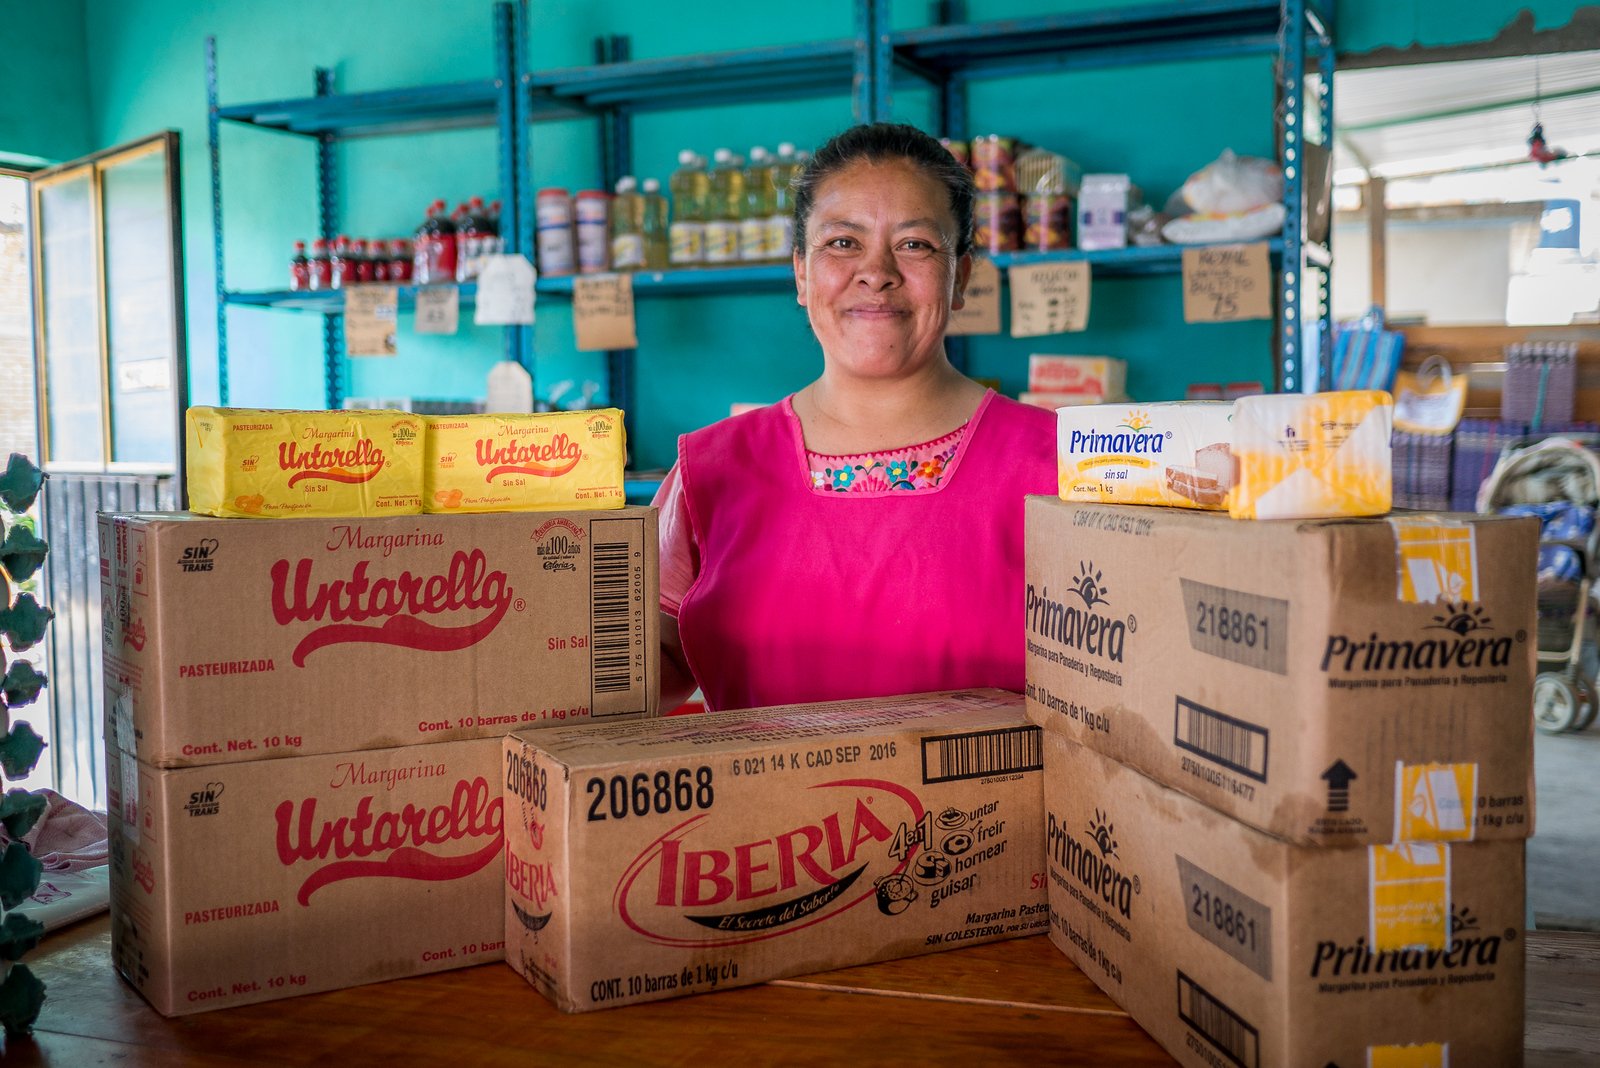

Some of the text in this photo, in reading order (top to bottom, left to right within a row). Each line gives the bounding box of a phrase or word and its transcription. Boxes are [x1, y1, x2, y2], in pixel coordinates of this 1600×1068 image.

[302, 428, 355, 442] Margarina
[429, 422, 469, 430] PASTEURIZADA
[498, 425, 549, 439] Margarina
[475, 432, 583, 466] Untarella
[1069, 429, 1164, 454] Primavera
[279, 438, 385, 471] Untarella
[503, 479, 526, 487] Sin Sal
[1104, 469, 1128, 479] sin sal
[317, 484, 328, 492] Sal
[575, 492, 593, 500] Cont.
[594, 491, 608, 499] Net.
[613, 490, 623, 498] kg
[1099, 484, 1103, 492] 1
[1105, 485, 1113, 494] kg
[375, 500, 392, 508] Cont.
[394, 499, 408, 507] Net.
[415, 499, 422, 507] kg
[183, 546, 210, 560] SIN
[326, 525, 445, 557] Margarina
[545, 541, 550, 555] de
[550, 536, 568, 555] 100
[568, 542, 581, 554] años
[182, 563, 214, 572] TRANS
[543, 560, 574, 572] Gloria
[270, 548, 513, 626] Untarella
[634, 566, 642, 601] 62005
[635, 610, 643, 645] 01013
[1025, 583, 1126, 663] Primavera
[1196, 600, 1270, 651] 218861
[548, 635, 588, 650] Sin Sal
[1320, 632, 1512, 672] Primavera
[179, 659, 275, 678] PASTEURIZADA
[635, 654, 643, 667] 75
[1027, 638, 1048, 659] Margarina
[1048, 650, 1059, 663] para
[1085, 664, 1089, 677] y
[1089, 663, 1122, 686] Repostería
[1327, 677, 1379, 690] Margarina
[1381, 678, 1403, 690] para
[1452, 678, 1459, 688] y
[418, 706, 589, 732] Cont. 10 barras de 1 kg c/u
[1038, 687, 1046, 704] 10
[1046, 690, 1068, 716] barras
[1069, 701, 1079, 720] de
[1096, 713, 1110, 734] c/u
[182, 735, 303, 756] Cont. Net. 10 kg
[732, 741, 897, 775] 6 021 14 K CAD SEP 2016
[330, 760, 447, 791] Margarina
[507, 750, 547, 812] 206868
[188, 791, 215, 805] SIN
[586, 765, 714, 822] 206868
[1488, 795, 1524, 808] barras
[189, 806, 220, 817] TRANS
[275, 776, 505, 866] Untarella
[969, 799, 999, 822] untar
[1506, 813, 1524, 825] c/u
[655, 797, 893, 907] IBERIA
[955, 839, 1007, 874] hornear
[505, 838, 558, 911] IBERIA
[1048, 812, 1132, 920] Primavera
[930, 872, 977, 909] guisar
[1069, 882, 1079, 901] para
[185, 900, 280, 925] PASTEURIZADA
[718, 906, 797, 930] El Secreto del
[966, 908, 1016, 924] Margarina
[1192, 884, 1257, 953] 218861
[925, 922, 1029, 946] SIN COLESTEROL POR SU
[1061, 917, 1069, 937] 10
[1069, 922, 1088, 953] barras
[1088, 938, 1097, 959] de
[422, 944, 477, 962] Cont. 10
[1310, 934, 1502, 978] Primavera
[188, 974, 307, 1002] Cont. Net. 10 kg
[590, 959, 738, 1002] CONT. 10 barras de 1 kg c/u
[1318, 982, 1366, 994] Margarina
[1369, 980, 1389, 991] para
[1440, 978, 1446, 987] y
